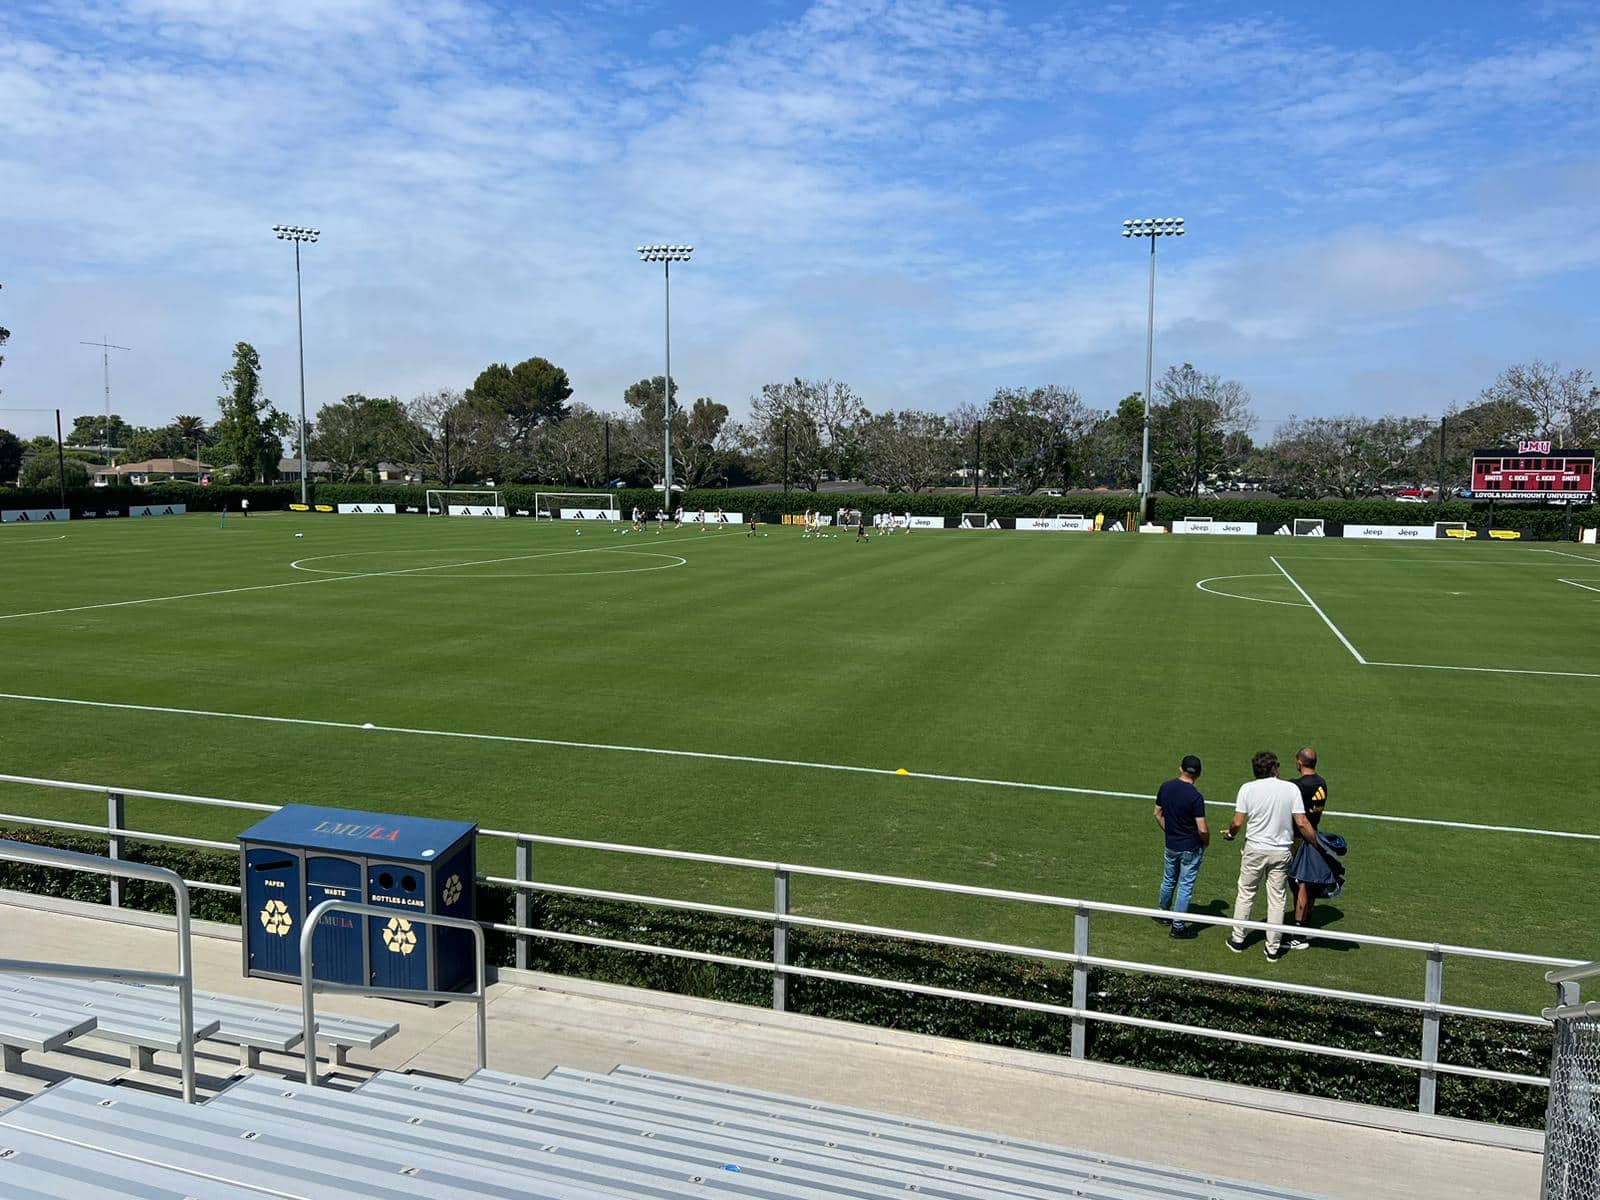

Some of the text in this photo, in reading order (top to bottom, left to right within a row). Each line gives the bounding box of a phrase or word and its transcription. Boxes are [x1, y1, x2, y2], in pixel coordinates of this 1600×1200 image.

[1519, 441, 1551, 454] LMU
[1190, 523, 1209, 531] Jeep
[1222, 524, 1241, 532] Jeep
[1363, 528, 1383, 536] Jeep
[1398, 528, 1418, 536] Jeep
[264, 879, 285, 888] PAPER
[324, 888, 346, 897] WASTE
[372, 894, 400, 904] BOTTLES
[407, 899, 424, 907] CANS
